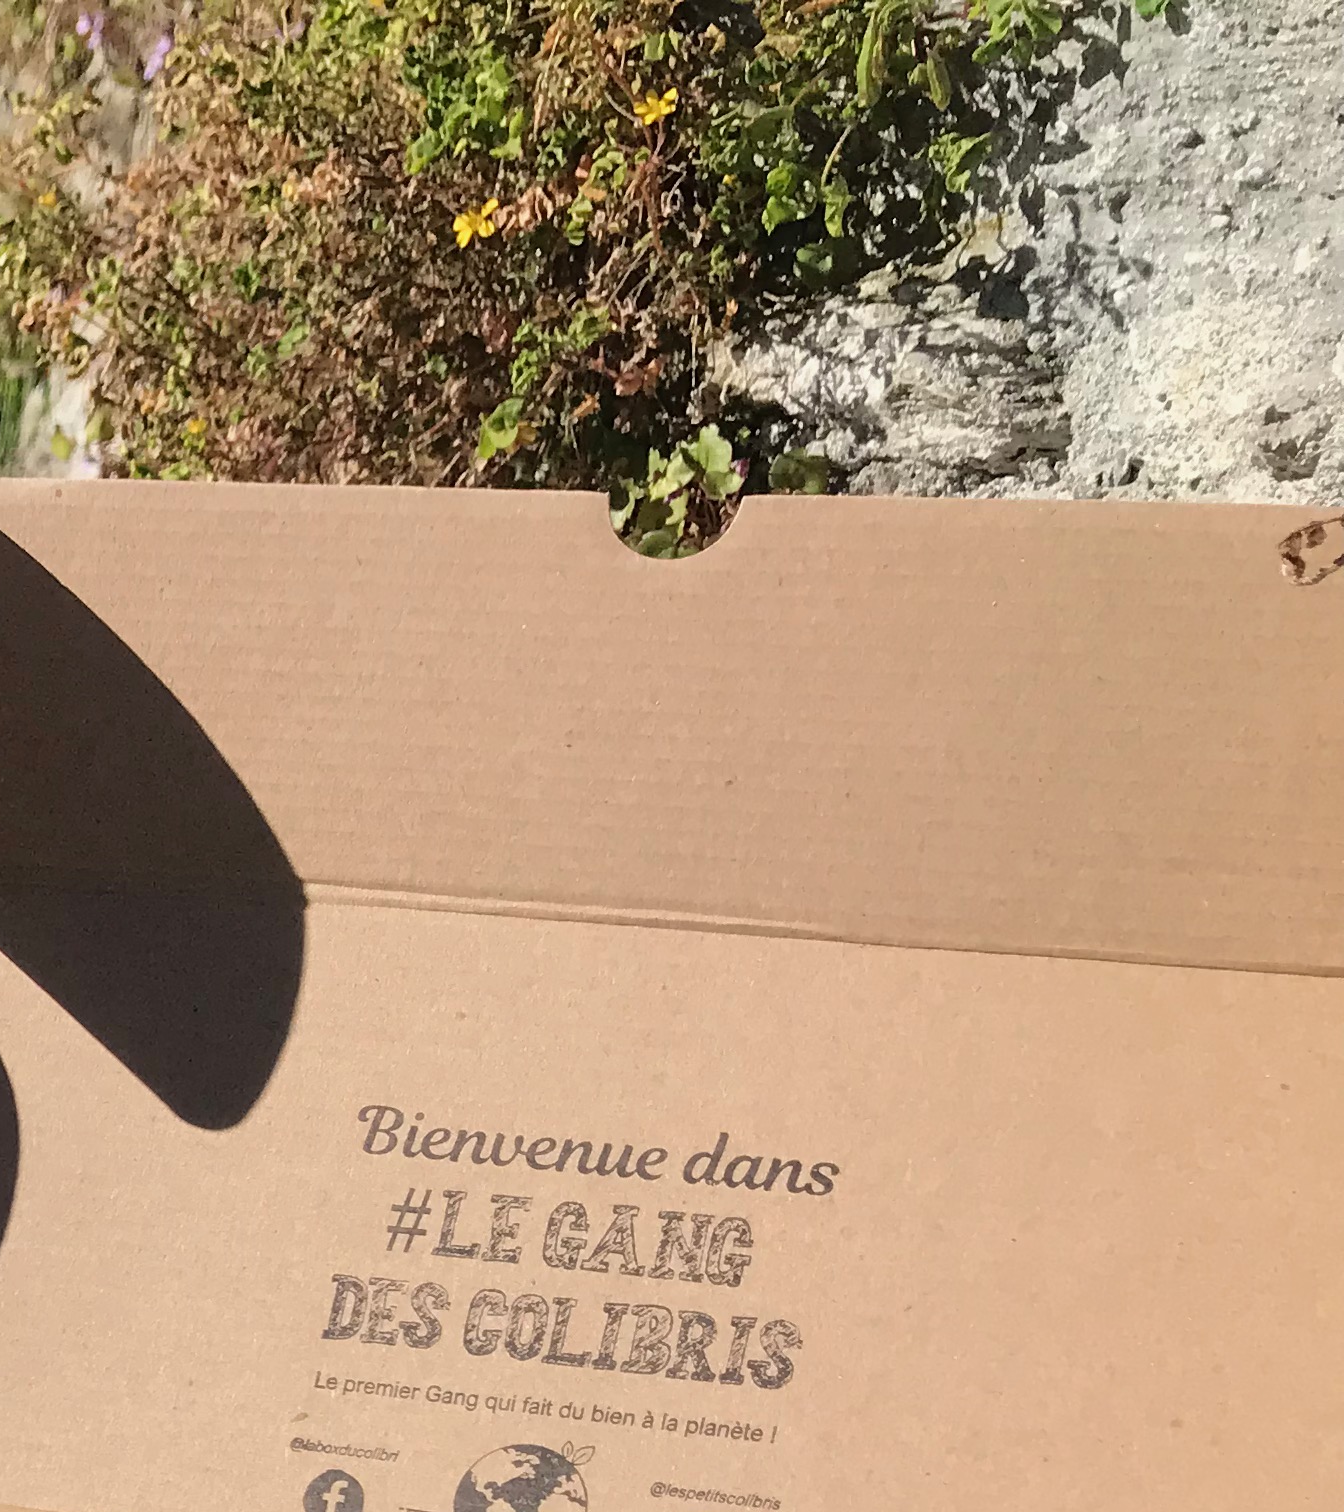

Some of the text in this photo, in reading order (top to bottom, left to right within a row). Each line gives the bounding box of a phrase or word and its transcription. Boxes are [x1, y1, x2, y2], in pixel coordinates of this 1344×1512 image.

[358, 1105, 840, 1196] Bienvenue dans
[542, 1200, 754, 1287] GANG
[321, 1273, 803, 1390] DES COLIBRIS
[314, 1371, 338, 1390] Le
[342, 1377, 421, 1402] premier
[425, 1385, 479, 1412] Gang
[484, 1394, 517, 1416] qui
[522, 1397, 553, 1418] fait
[559, 1402, 584, 1421] du
[591, 1405, 635, 1427] bien
[641, 1410, 655, 1430] à
[660, 1413, 678, 1432] la
[683, 1417, 764, 1443] planète
[650, 1481, 782, 1511] @lespetitscolibris
